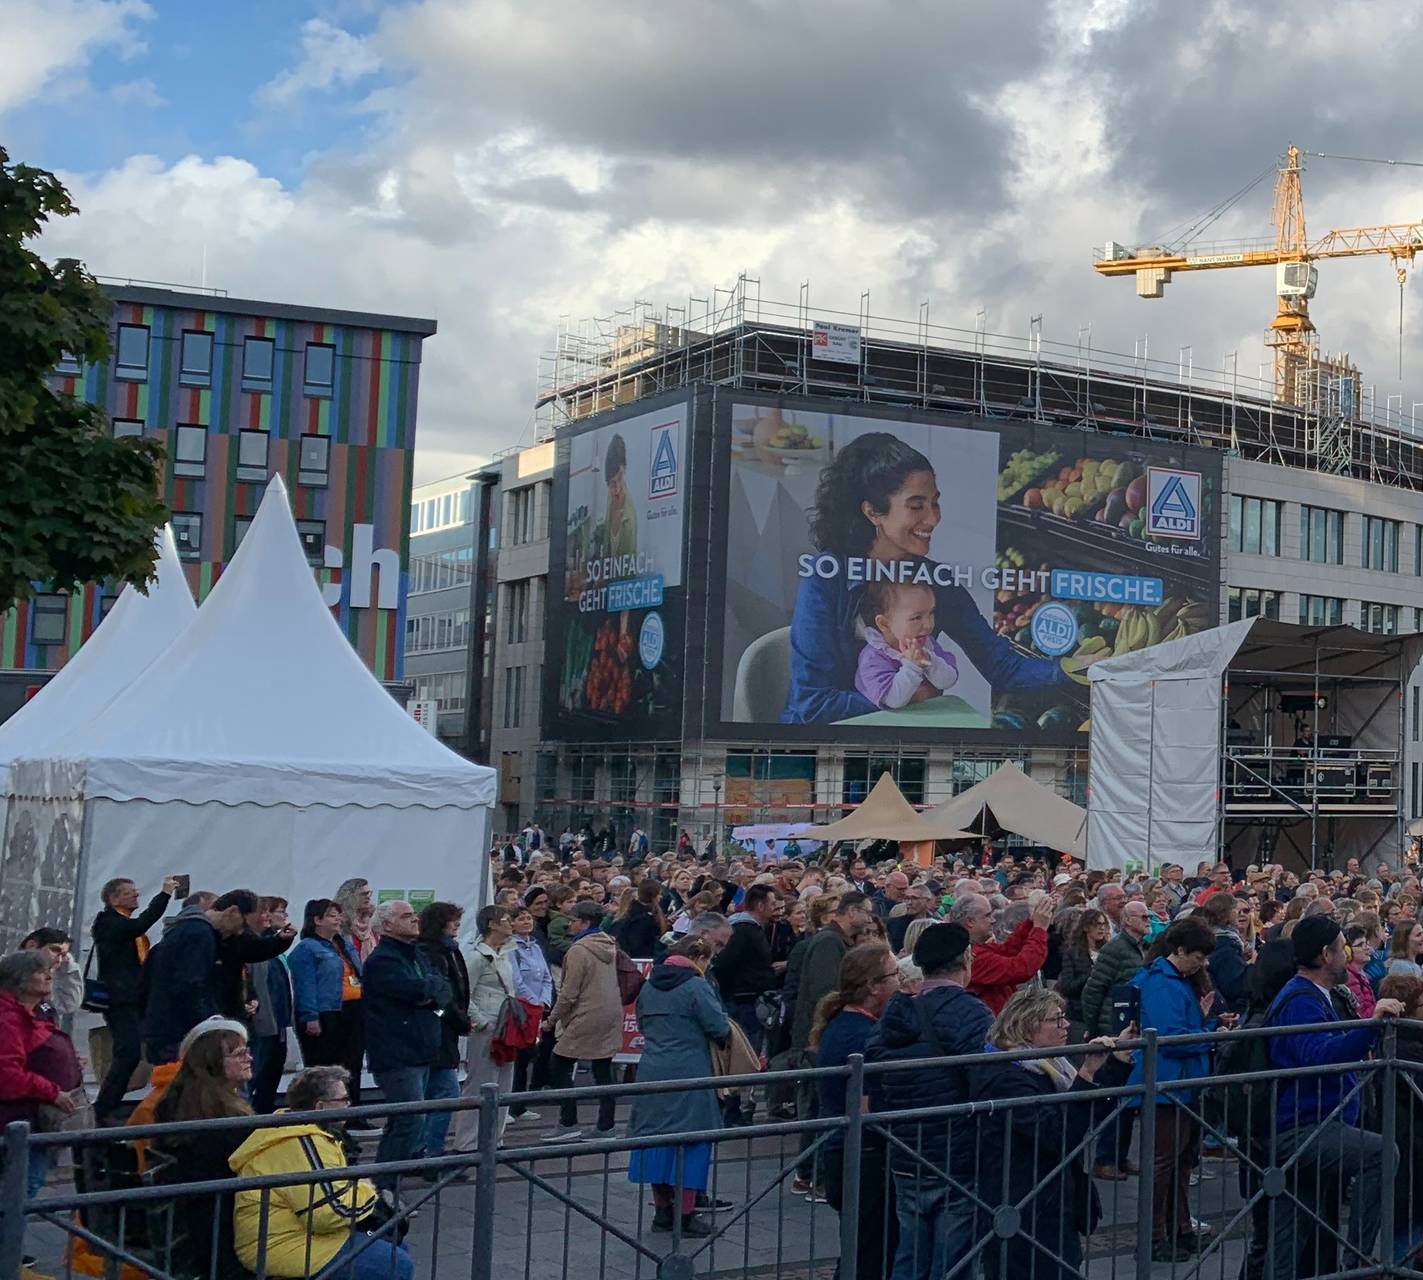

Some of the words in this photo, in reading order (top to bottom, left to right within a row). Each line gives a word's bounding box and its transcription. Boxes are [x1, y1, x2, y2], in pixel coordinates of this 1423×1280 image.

[653, 475, 674, 492] ALDI
[1156, 517, 1192, 531] ALDI
[1145, 541, 1169, 554] Gutes
[1171, 544, 1183, 555] für
[1184, 545, 1200, 557] alle.
[586, 559, 600, 582] SO
[603, 551, 654, 580] EINFACH
[798, 553, 840, 579] SO
[847, 557, 973, 588] EINFACH
[981, 567, 1051, 593] GEHT
[1056, 573, 1161, 603] FRISCHE.
[579, 587, 607, 612] GEHT
[608, 579, 662, 609] FRISCHE.
[1038, 619, 1073, 640] ALDI
